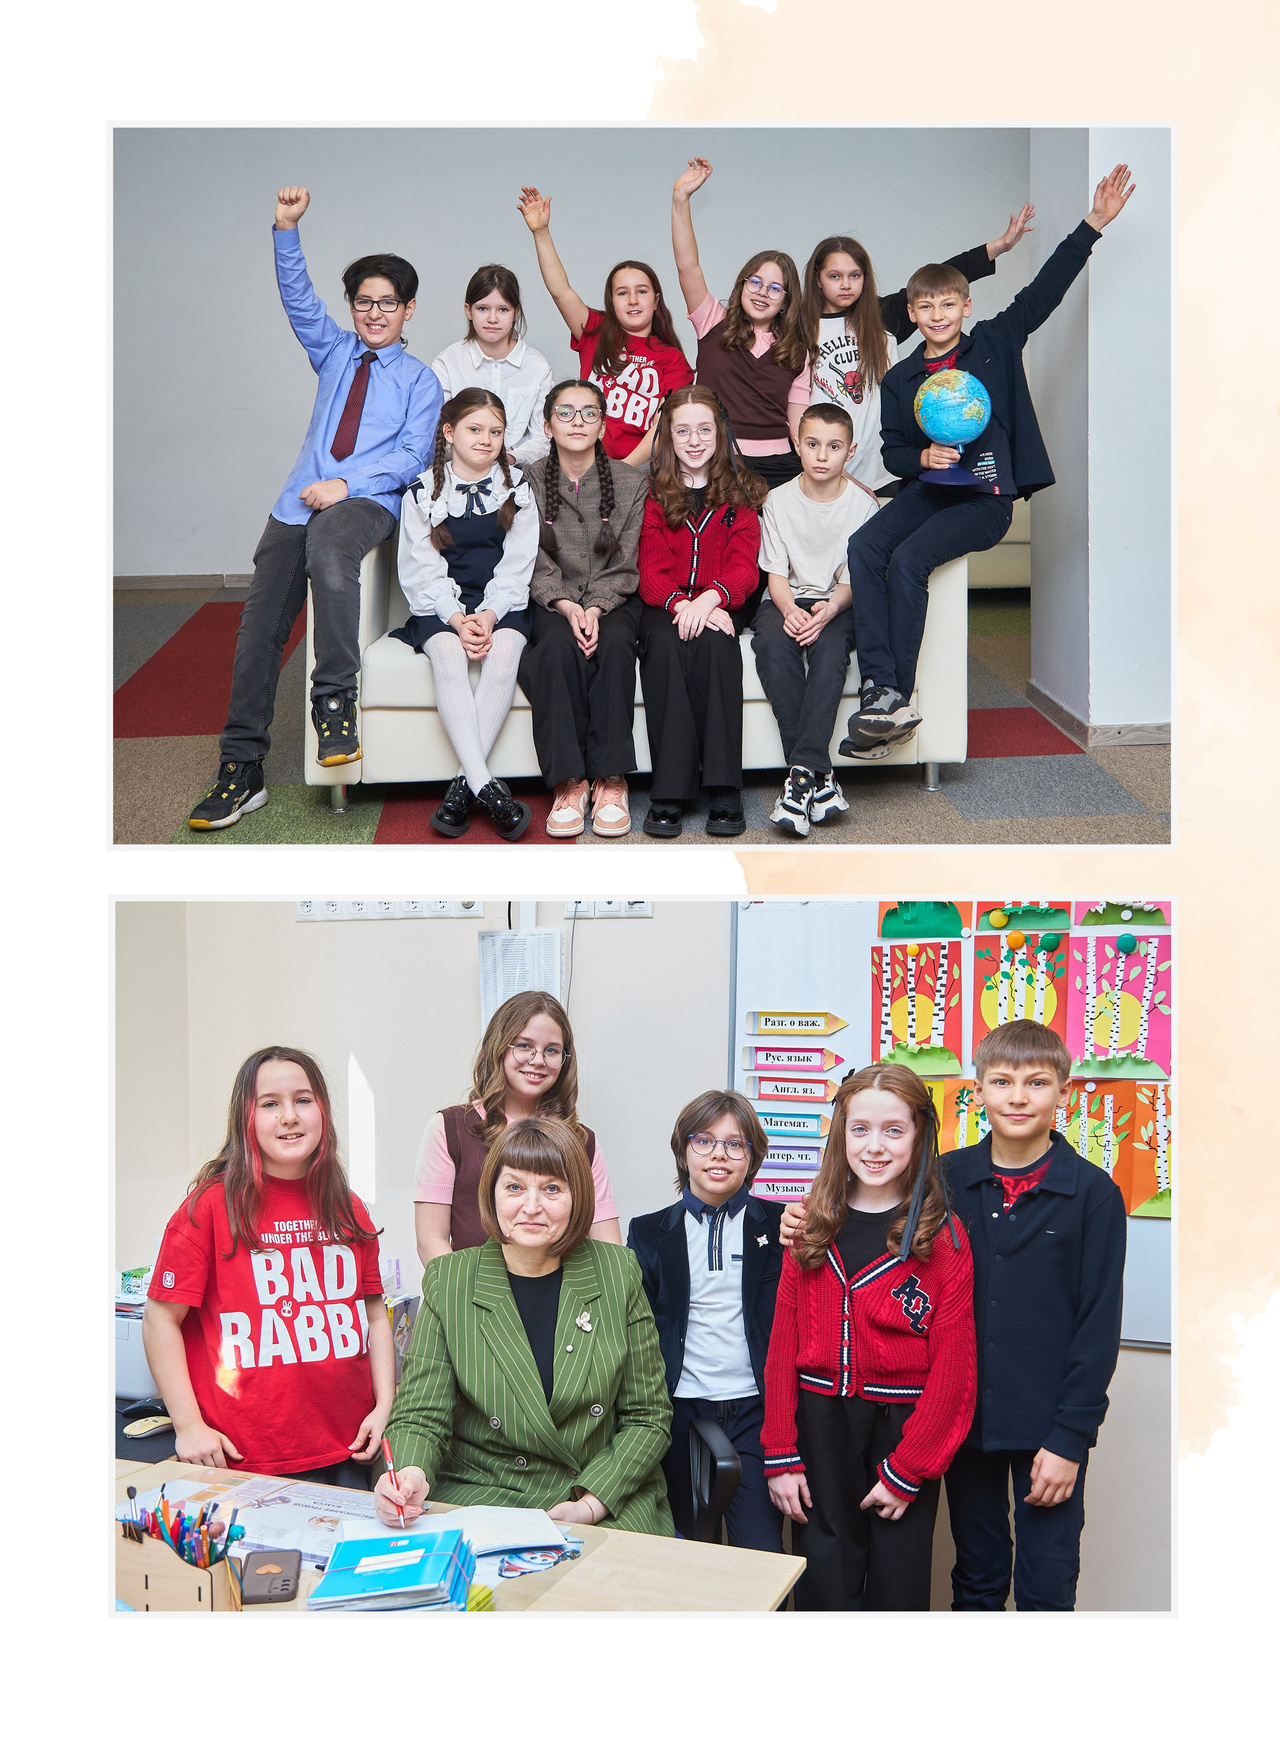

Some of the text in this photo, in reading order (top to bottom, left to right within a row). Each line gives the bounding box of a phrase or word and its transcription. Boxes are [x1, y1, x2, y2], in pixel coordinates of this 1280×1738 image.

[819, 335, 858, 360] HELLFI
[764, 1017, 787, 1028] Разг.
[798, 1019, 821, 1027] важ.
[765, 1052, 813, 1065] Рус. язык
[772, 1084, 816, 1095] Англ. яз.
[763, 1117, 809, 1128] Математ.
[797, 1153, 811, 1161] чт.
[765, 1183, 806, 1194] Музыка
[261, 1230, 340, 1244] UNDER THE BLE
[250, 1244, 358, 1306] BAD
[219, 1299, 371, 1369] RABBI
